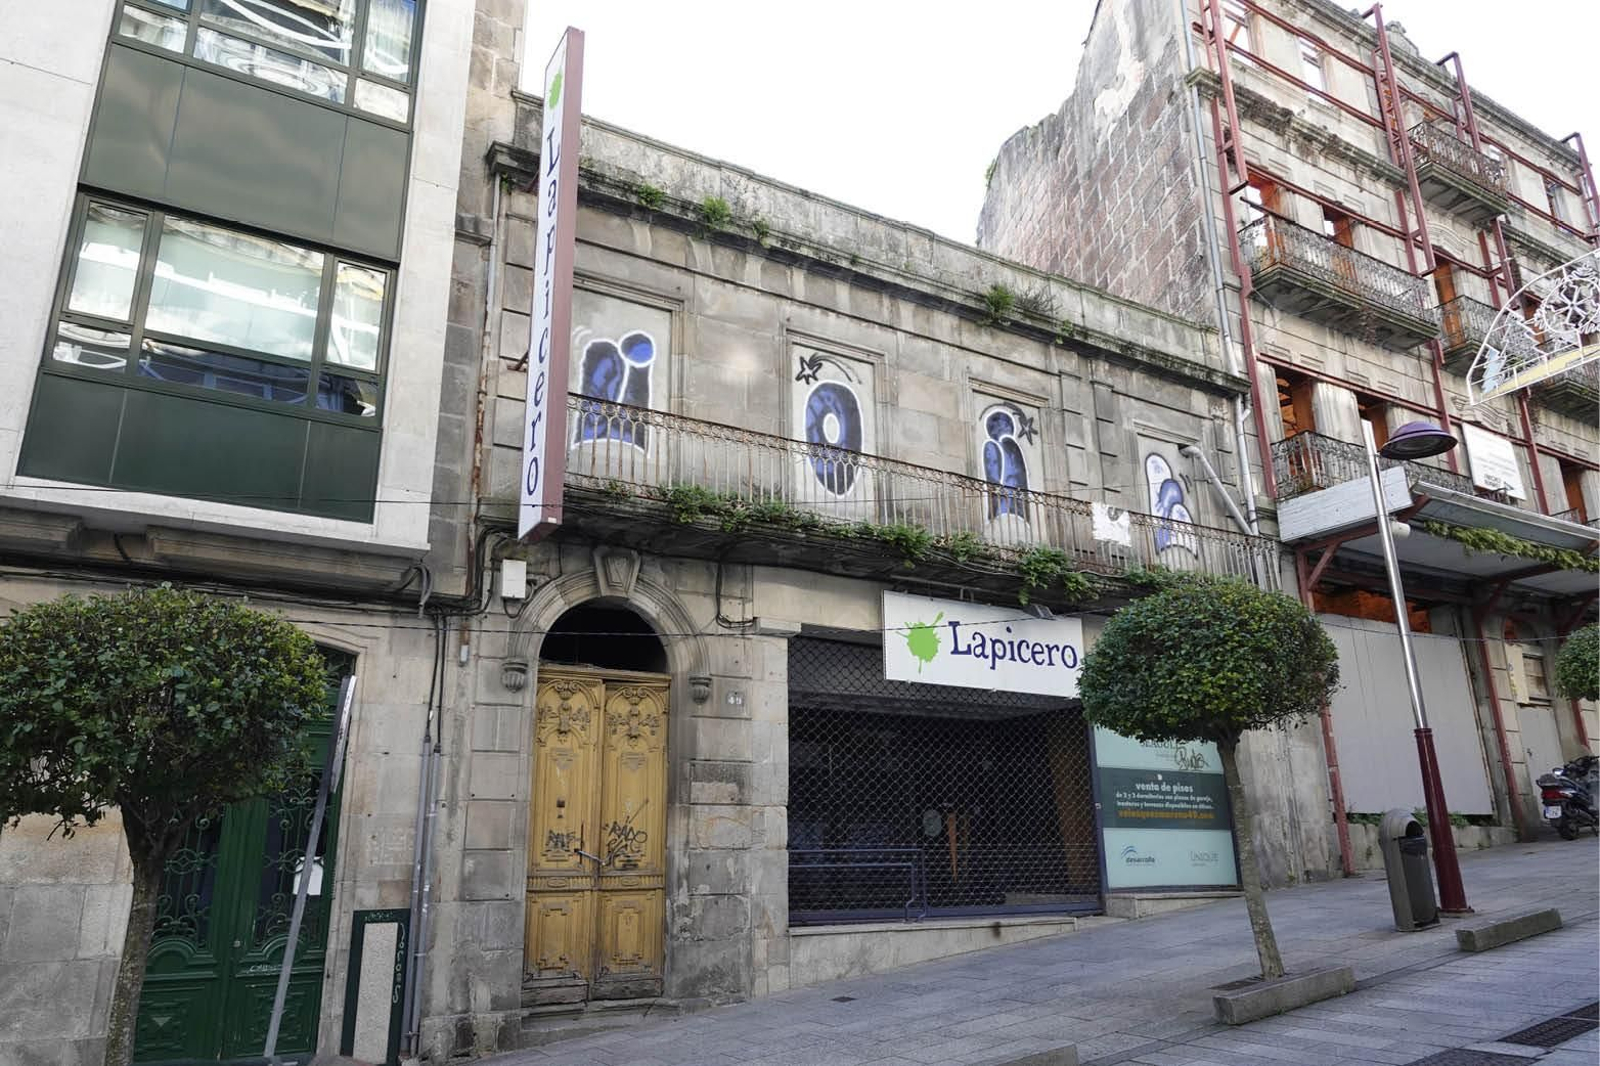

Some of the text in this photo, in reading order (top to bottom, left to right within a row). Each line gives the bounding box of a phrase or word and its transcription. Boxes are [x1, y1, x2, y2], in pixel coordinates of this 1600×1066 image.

[527, 126, 561, 496] Lapicero
[947, 620, 1078, 670] Lapicero
[1135, 782, 1194, 794] venta de pisos
